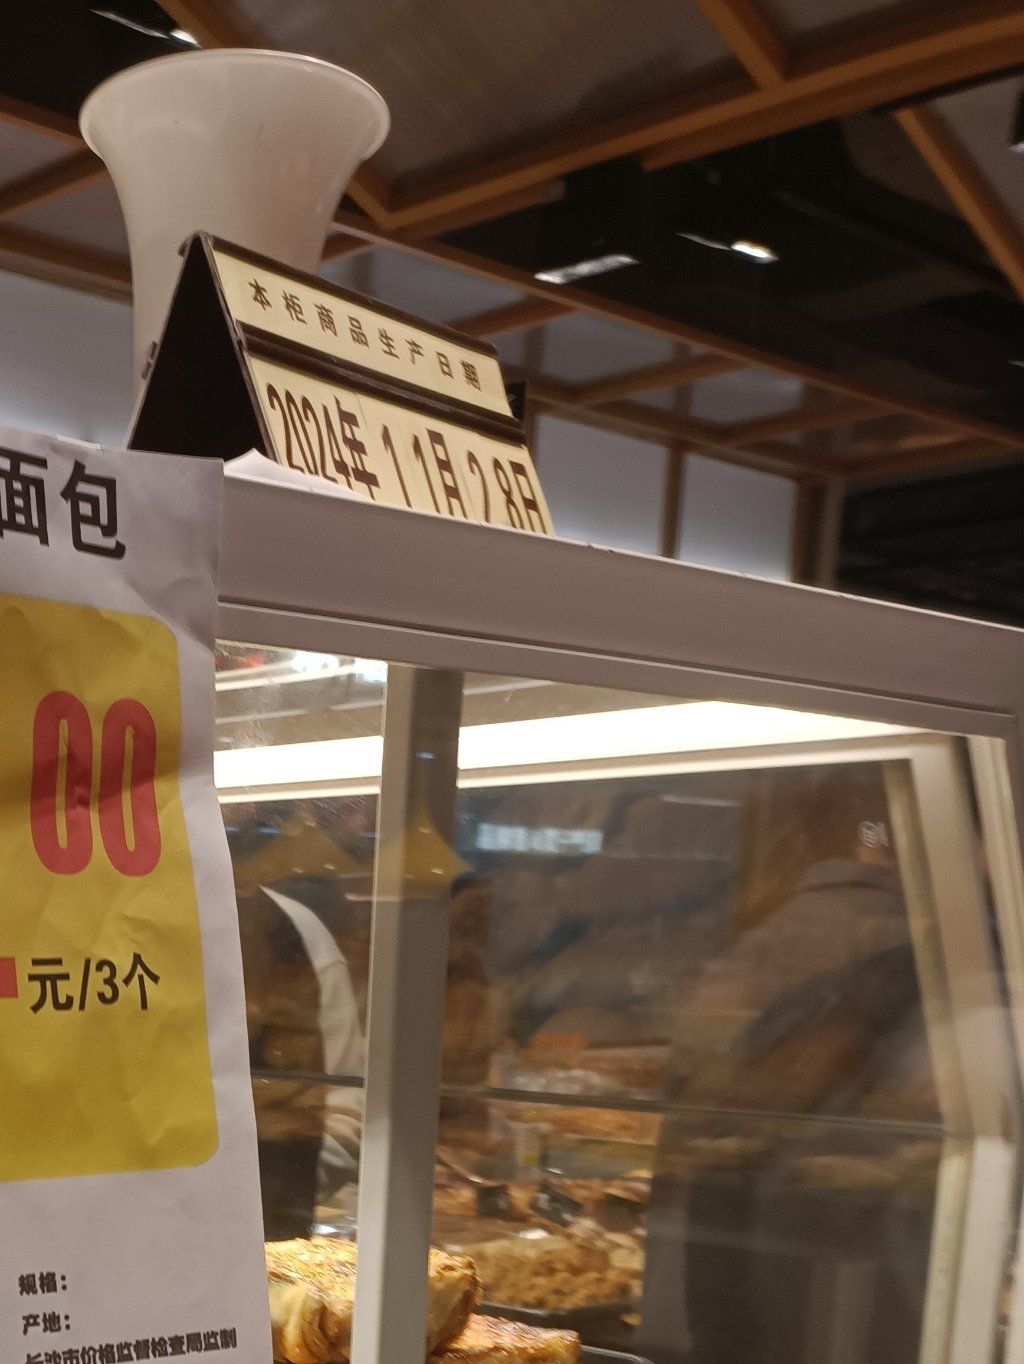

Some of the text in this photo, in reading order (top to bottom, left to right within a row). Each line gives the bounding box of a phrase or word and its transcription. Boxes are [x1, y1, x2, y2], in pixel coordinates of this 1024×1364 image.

[247, 278, 482, 391] 本柜商品生产日期
[29, 690, 162, 877] 00
[28, 952, 160, 1014] 元/3个
[18, 1271, 68, 1296] 规格：
[22, 1311, 71, 1335] 产地：
